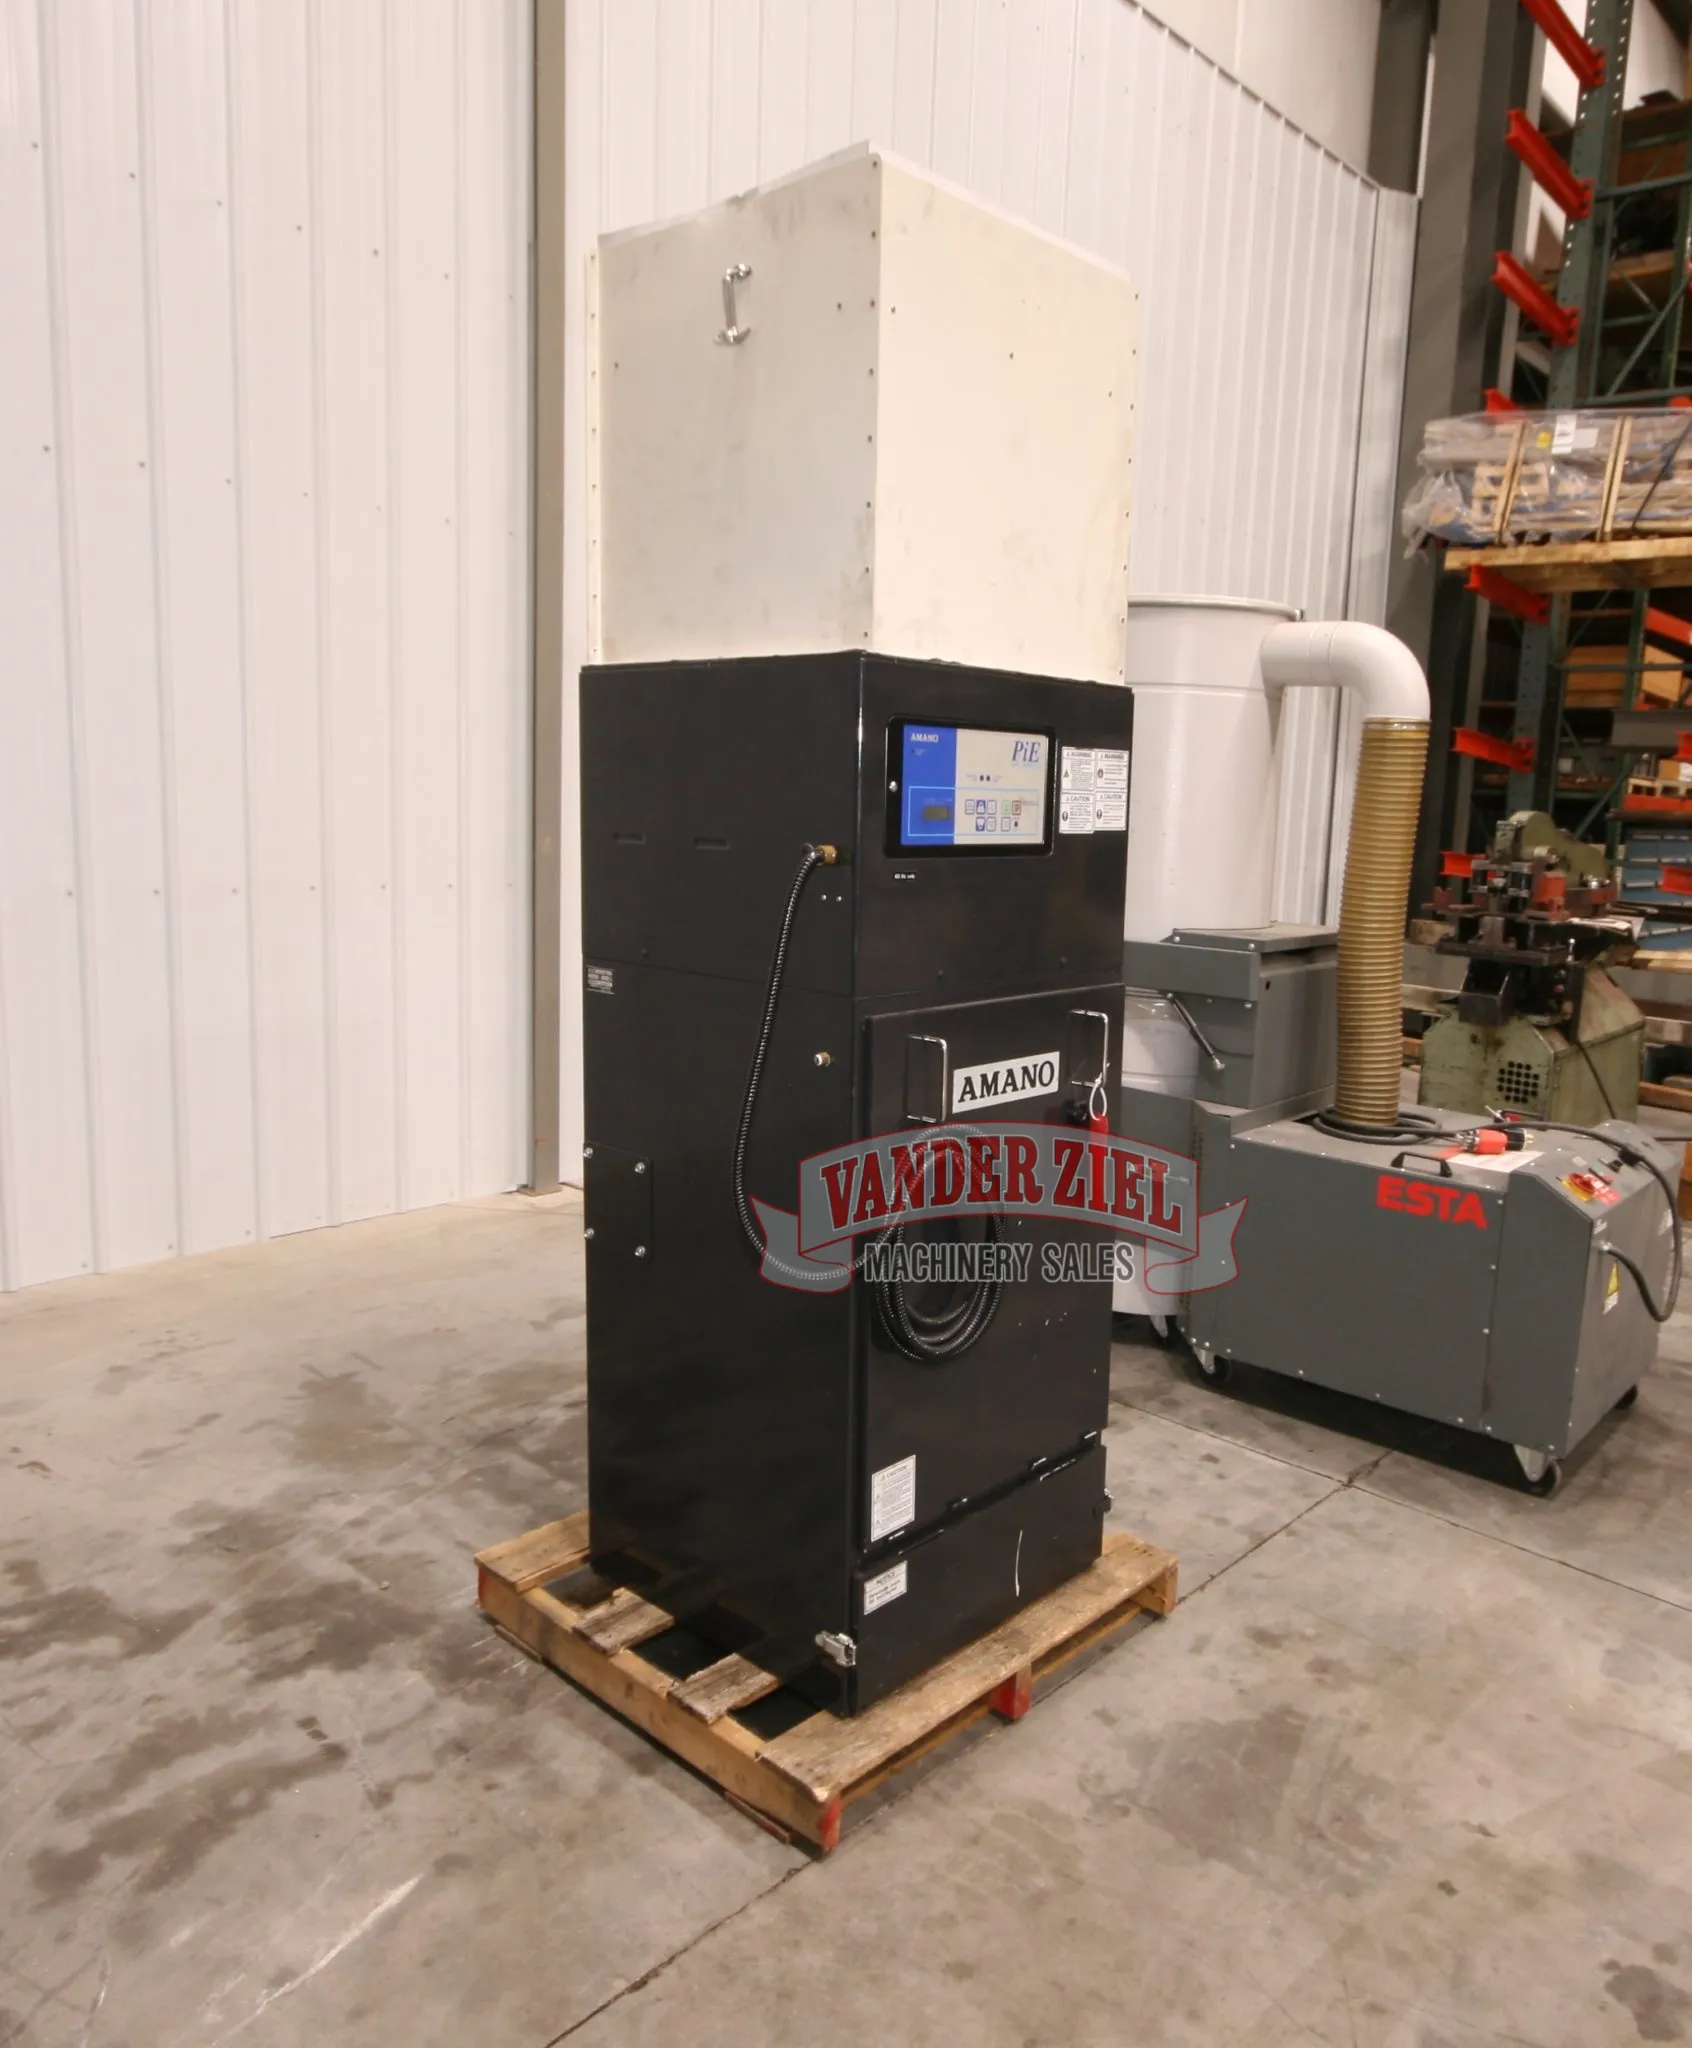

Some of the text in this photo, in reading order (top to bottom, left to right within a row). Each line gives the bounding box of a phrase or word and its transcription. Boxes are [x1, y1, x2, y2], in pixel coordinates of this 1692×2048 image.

[910, 732, 939, 743] AMANO
[1011, 740, 1042, 763] PiE
[957, 1060, 1055, 1103] AMANO
[1376, 1174, 1488, 1230] ESTA
